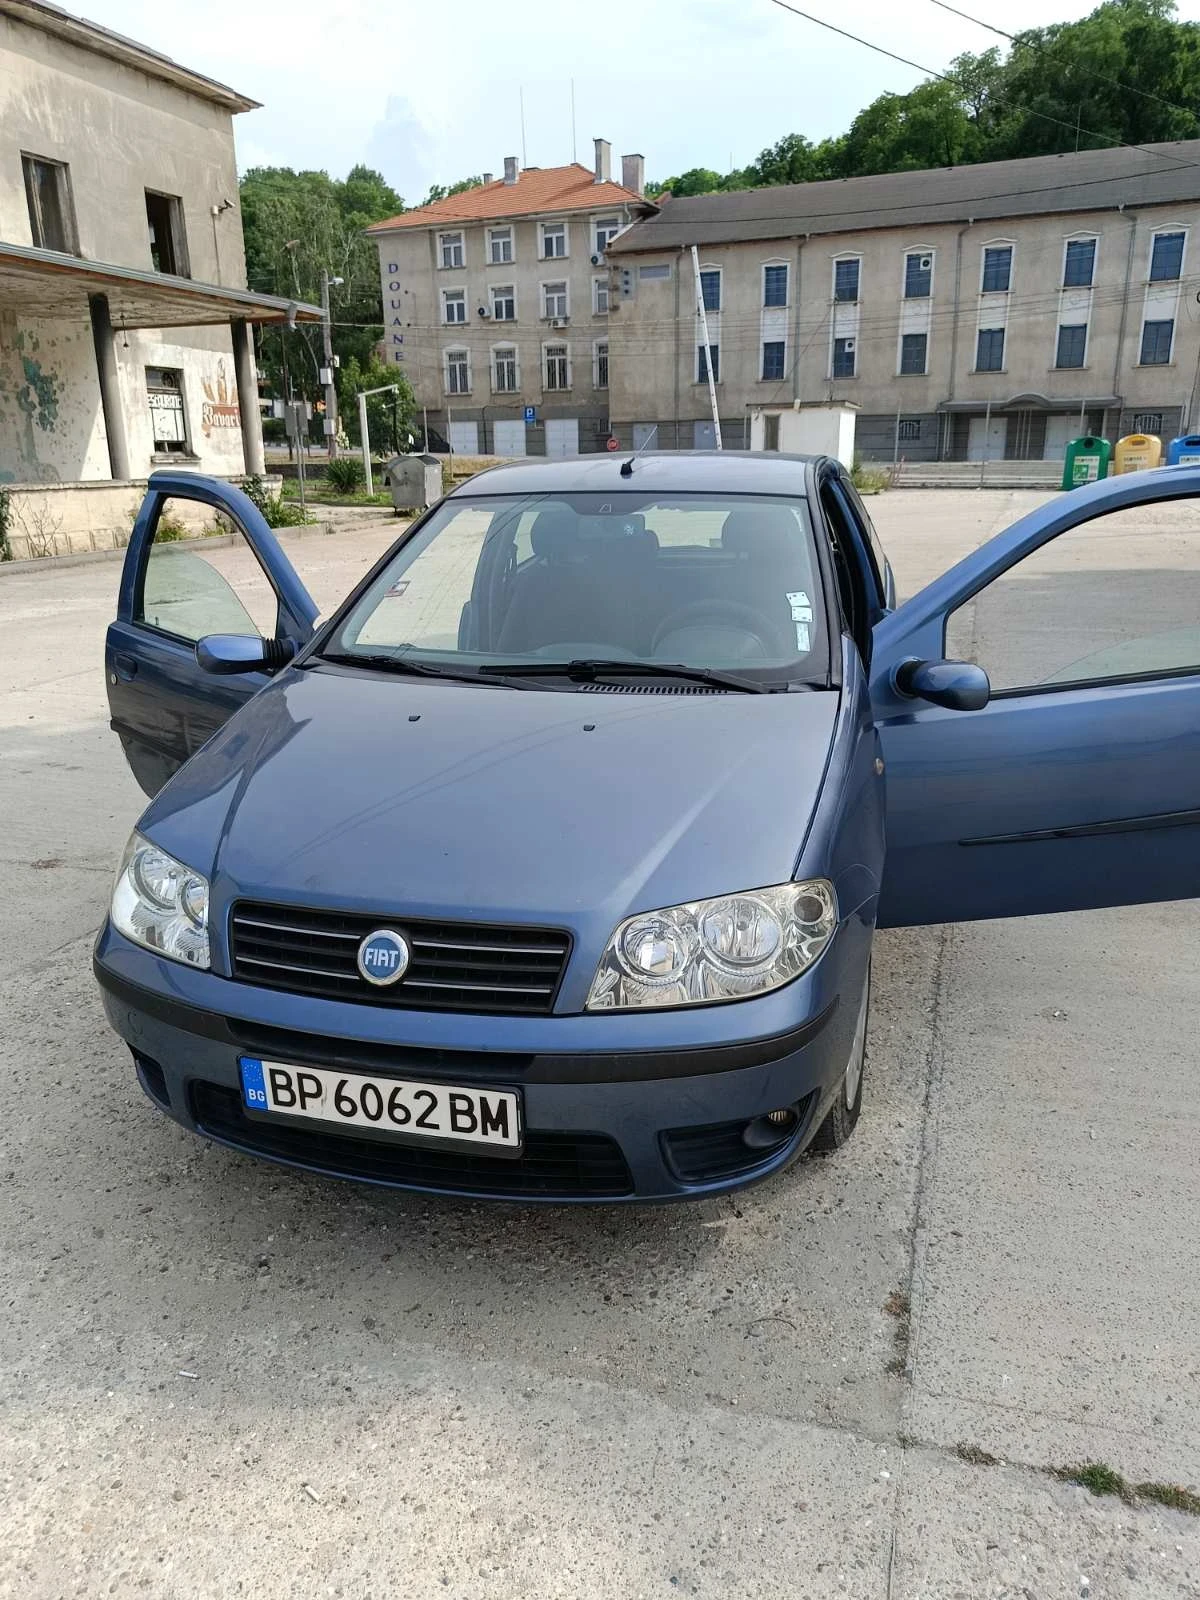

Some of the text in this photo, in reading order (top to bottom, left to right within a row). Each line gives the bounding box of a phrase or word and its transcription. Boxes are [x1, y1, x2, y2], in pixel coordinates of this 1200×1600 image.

[388, 263, 404, 362] DOUANE
[202, 402, 241, 427] Bavari
[364, 947, 399, 968] FIAT
[248, 1088, 265, 1102] BG
[268, 1067, 509, 1139] BP 6062 BM
